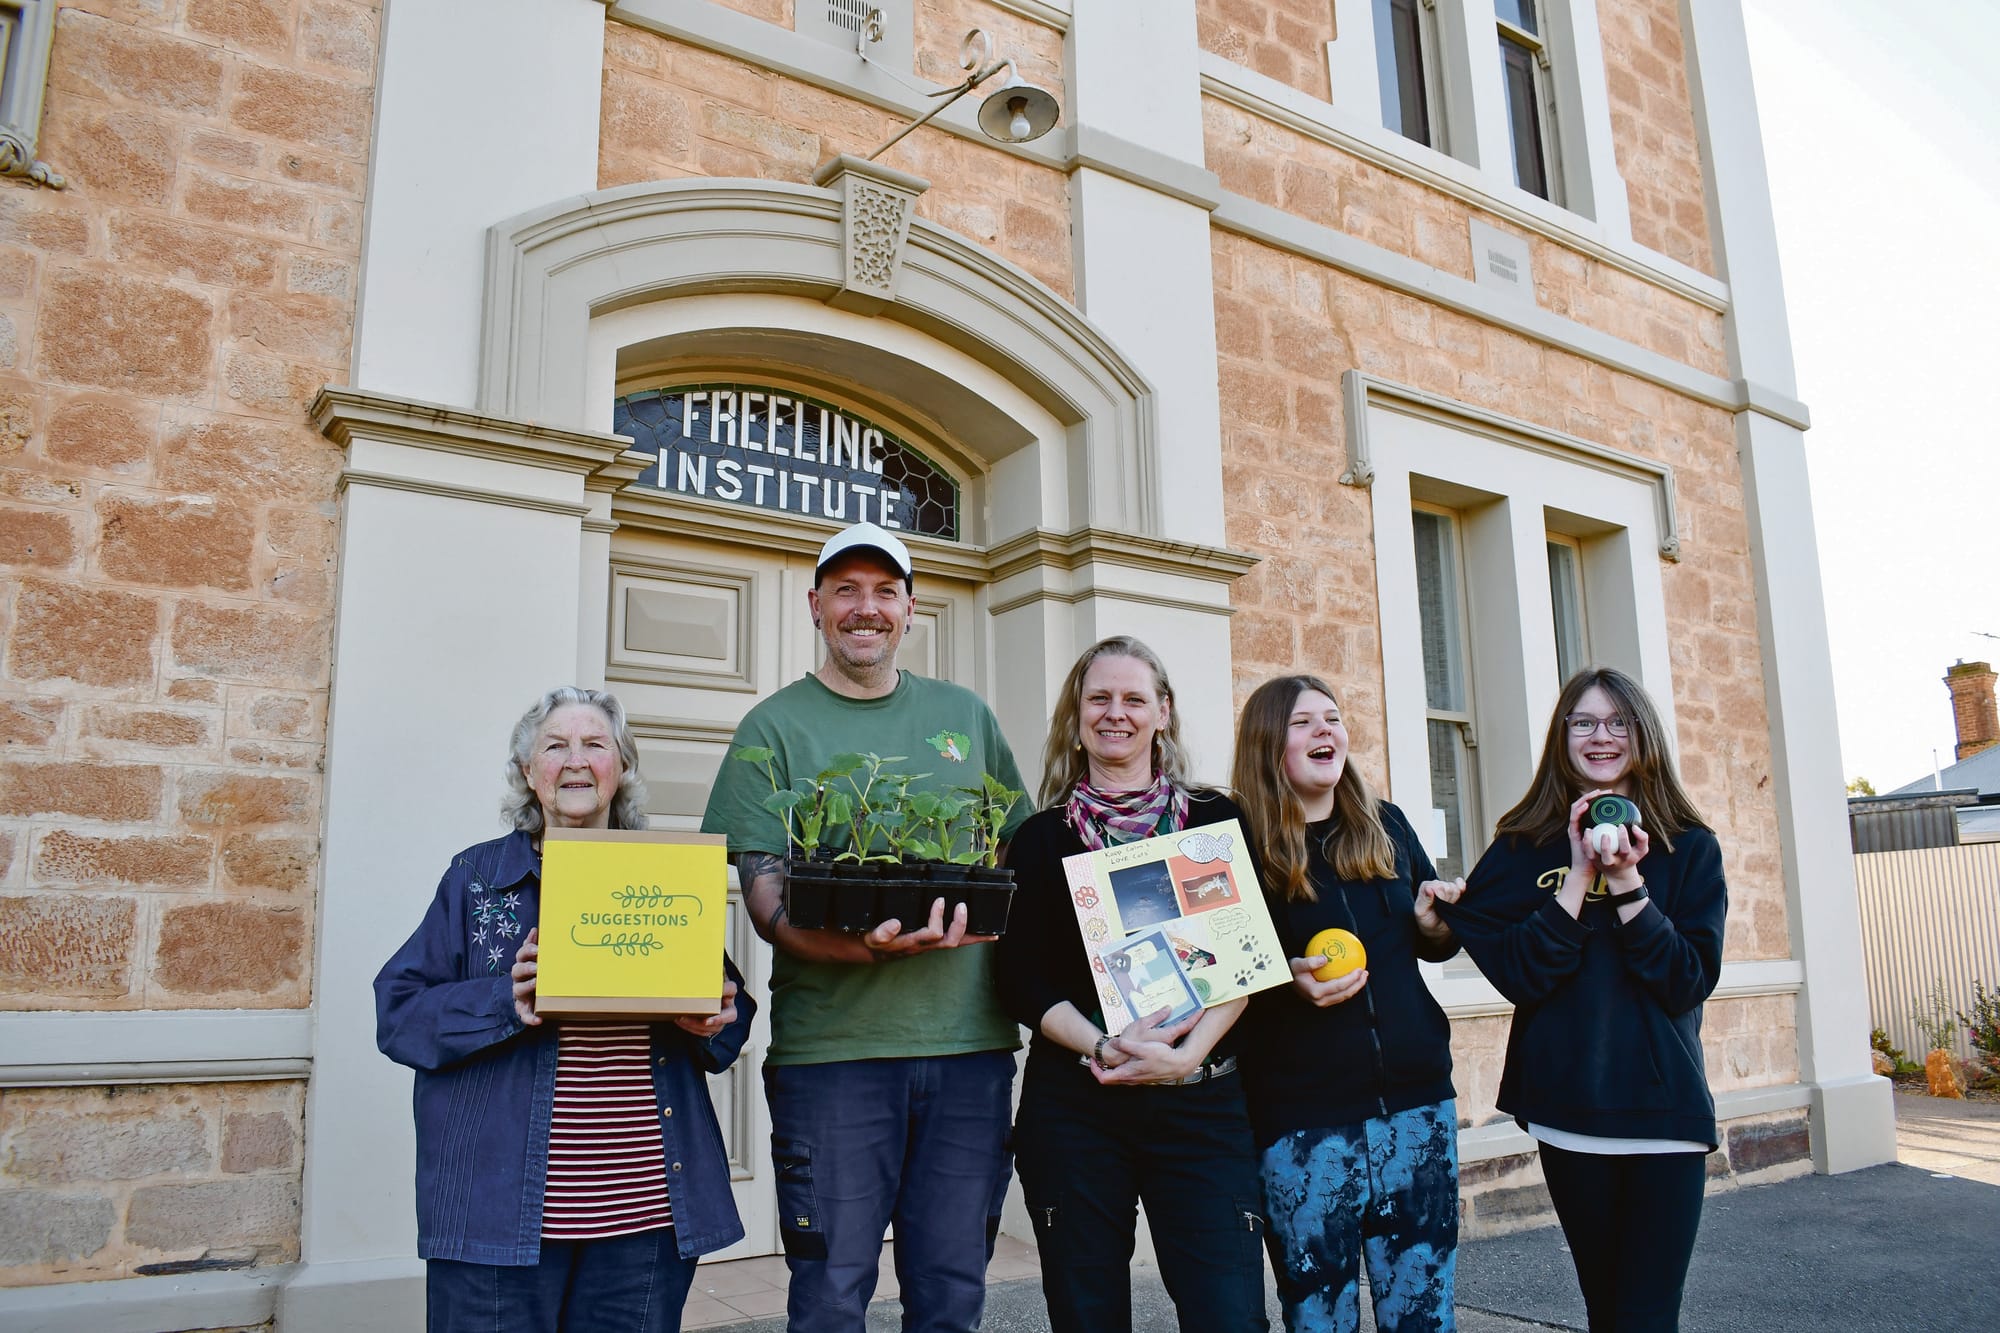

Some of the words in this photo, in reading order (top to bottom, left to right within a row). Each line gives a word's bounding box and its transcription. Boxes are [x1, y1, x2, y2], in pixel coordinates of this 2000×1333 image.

[682, 391, 884, 475] FREELING
[658, 448, 901, 529] INSTITUTE
[580, 912, 688, 927] SUGGESTIONS
